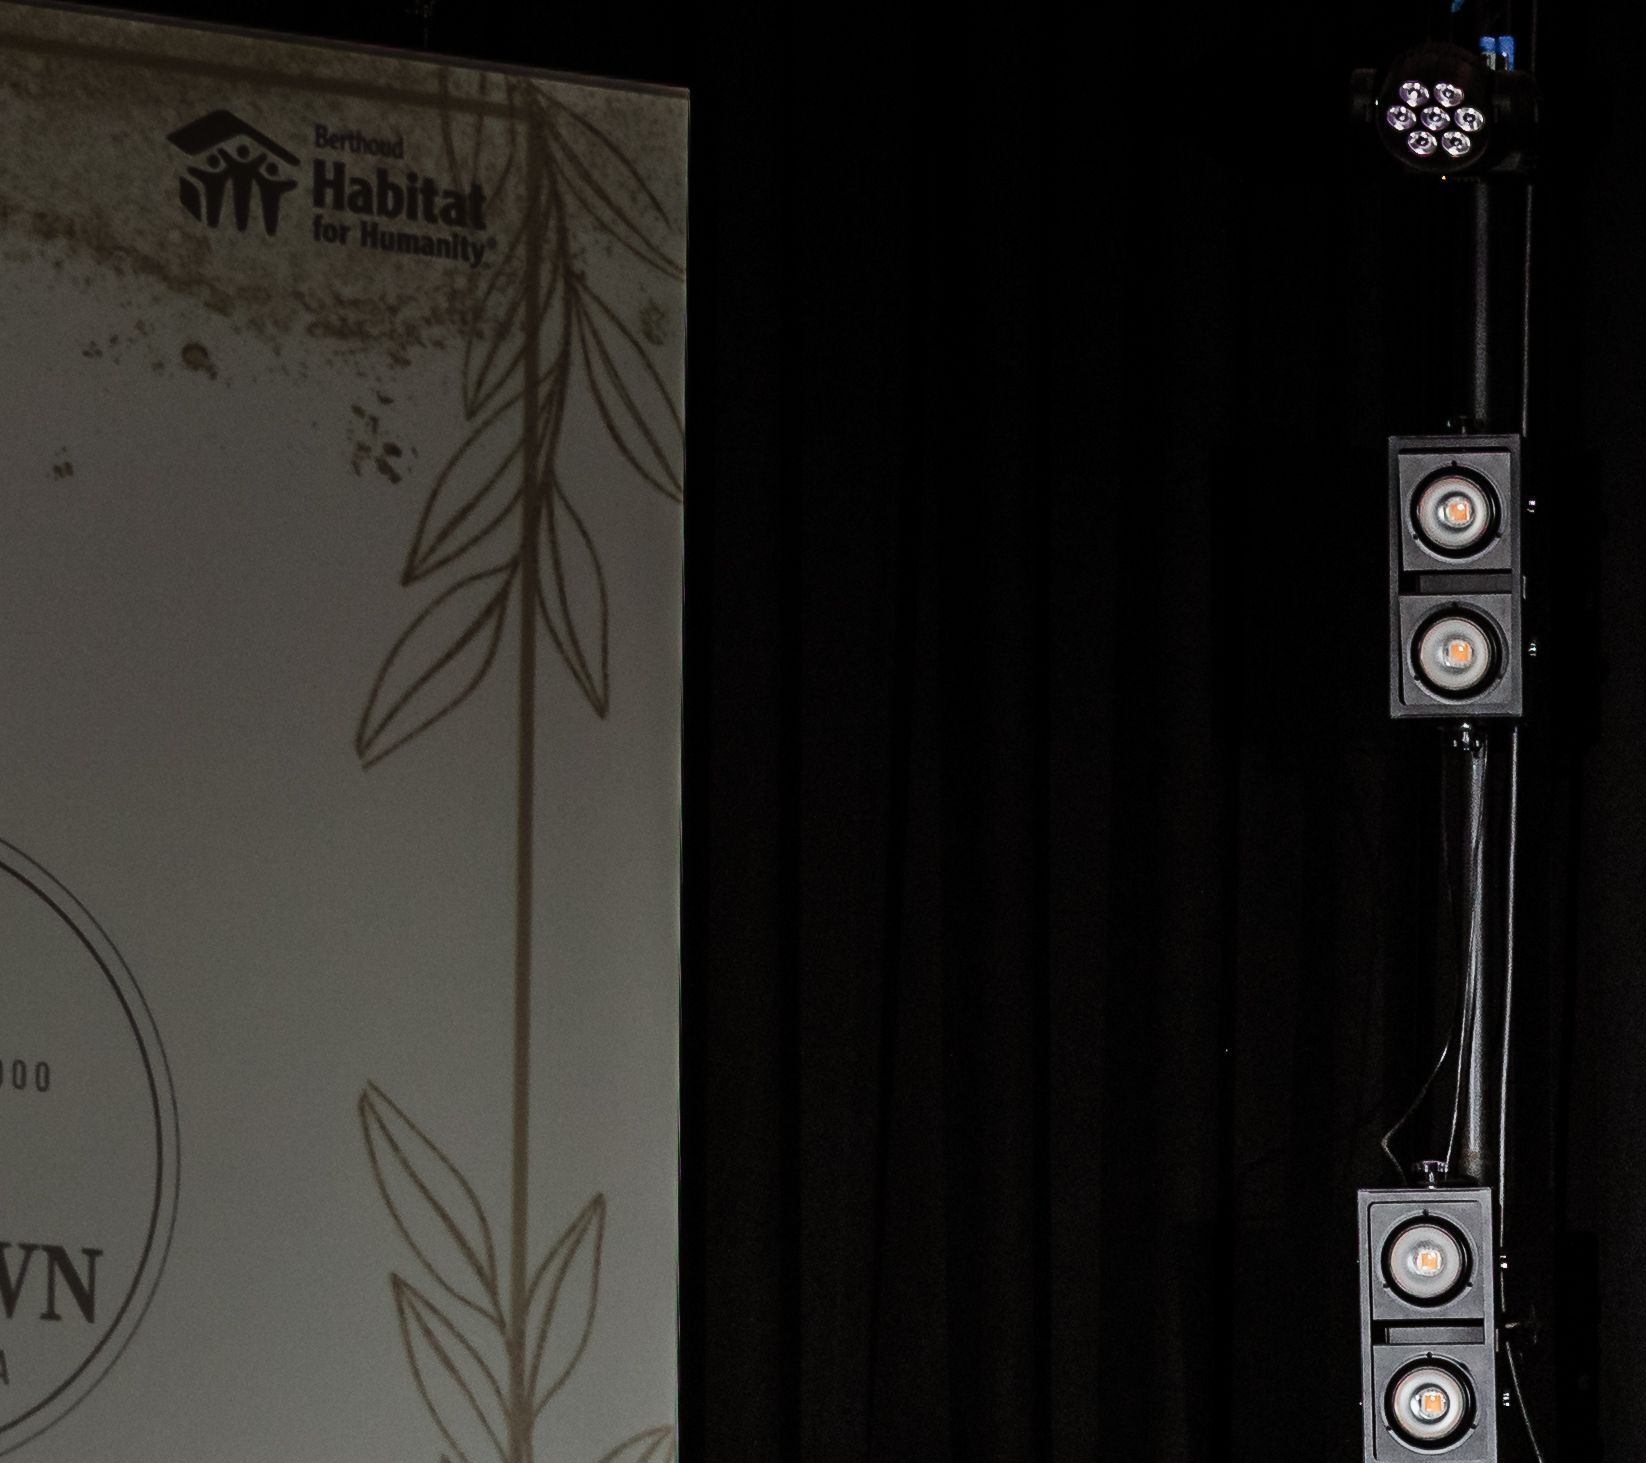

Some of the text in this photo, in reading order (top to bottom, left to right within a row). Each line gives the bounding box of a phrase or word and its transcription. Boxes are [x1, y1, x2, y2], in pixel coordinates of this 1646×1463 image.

[315, 124, 404, 159] Berthoud
[313, 159, 487, 231] Habitat
[313, 213, 349, 246] for
